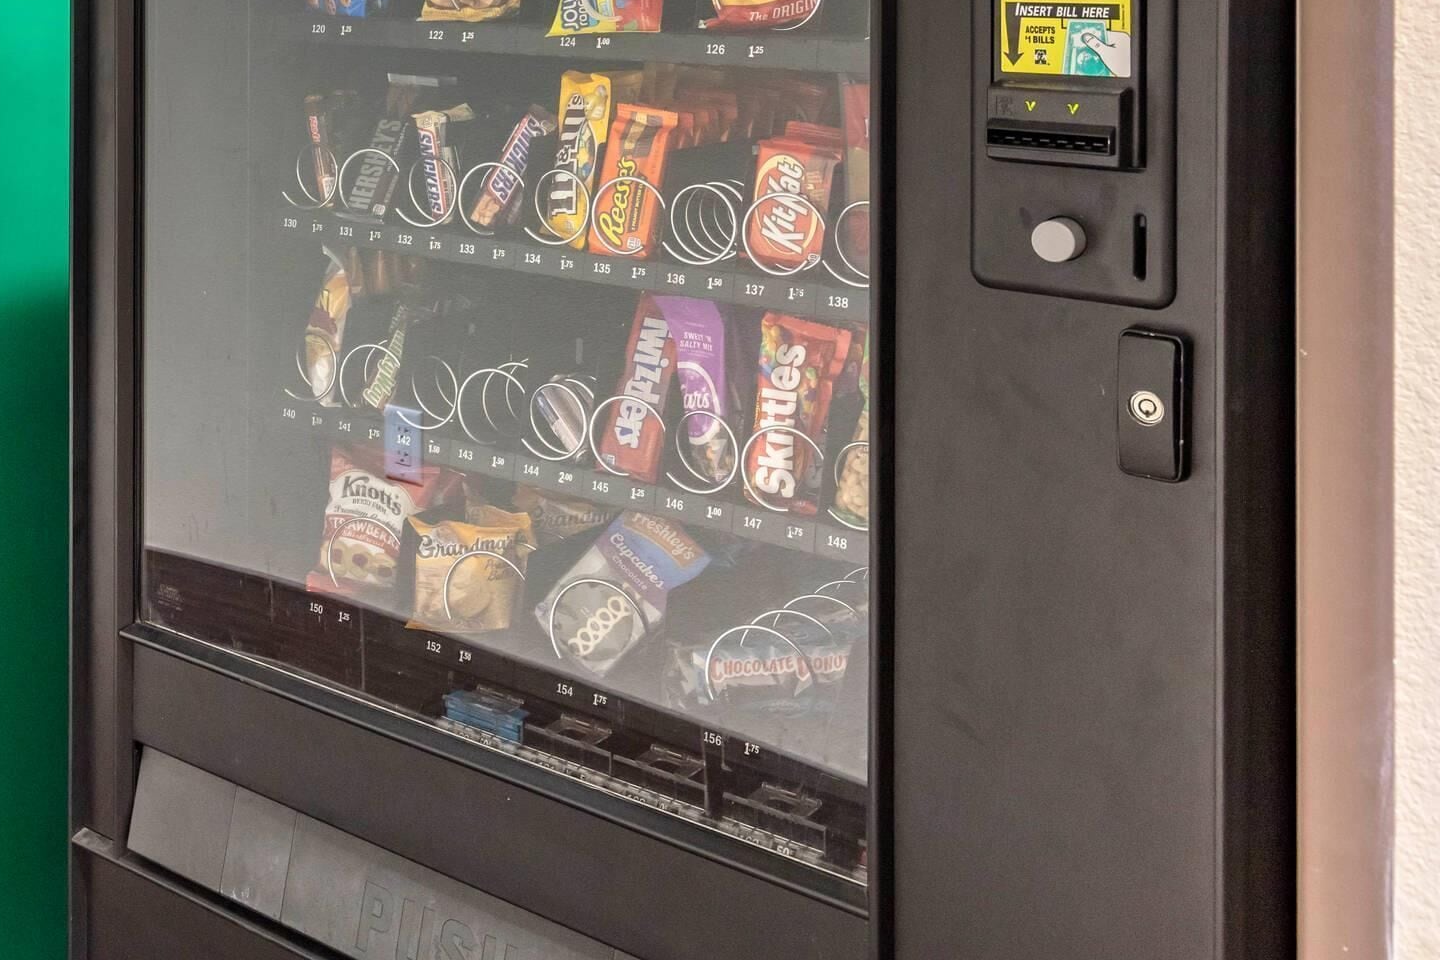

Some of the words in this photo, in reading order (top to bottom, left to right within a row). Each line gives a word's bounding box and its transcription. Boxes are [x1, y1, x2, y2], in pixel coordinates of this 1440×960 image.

[1015, 2, 1053, 17] INSERT
[1056, 6, 1078, 17] BILL
[1082, 7, 1110, 18] HERE
[312, 24, 326, 34] 120
[429, 30, 444, 40] 122
[1025, 25, 1055, 34] ACCEPTS
[560, 37, 576, 47] 124
[1033, 36, 1055, 44] BILLS
[706, 44, 725, 55] 126
[599, 157, 636, 246] Reese's
[283, 218, 297, 229] 130
[339, 226, 353, 236] 131
[398, 234, 412, 245] 132
[459, 243, 475, 254] 133
[525, 253, 541, 264] 134
[593, 263, 610, 274] 135
[667, 273, 685, 284] 136
[745, 284, 764, 296] 137
[828, 296, 849, 308] 138
[282, 408, 296, 419] 140
[338, 421, 351, 431] 141
[755, 343, 807, 499] Skittles
[396, 434, 411, 445] 142
[458, 448, 473, 460] 143
[523, 464, 539, 476] 144
[592, 480, 609, 492] 145
[342, 475, 402, 516] Knott's
[666, 498, 684, 510] 146
[744, 516, 762, 529] 147
[827, 535, 848, 550] 148
[610, 533, 665, 590] Cupcakes
[310, 602, 323, 614] 150
[426, 640, 441, 653] 152
[711, 655, 795, 681] CHOCOLATE
[556, 682, 573, 697] 154
[704, 731, 722, 746] 156
